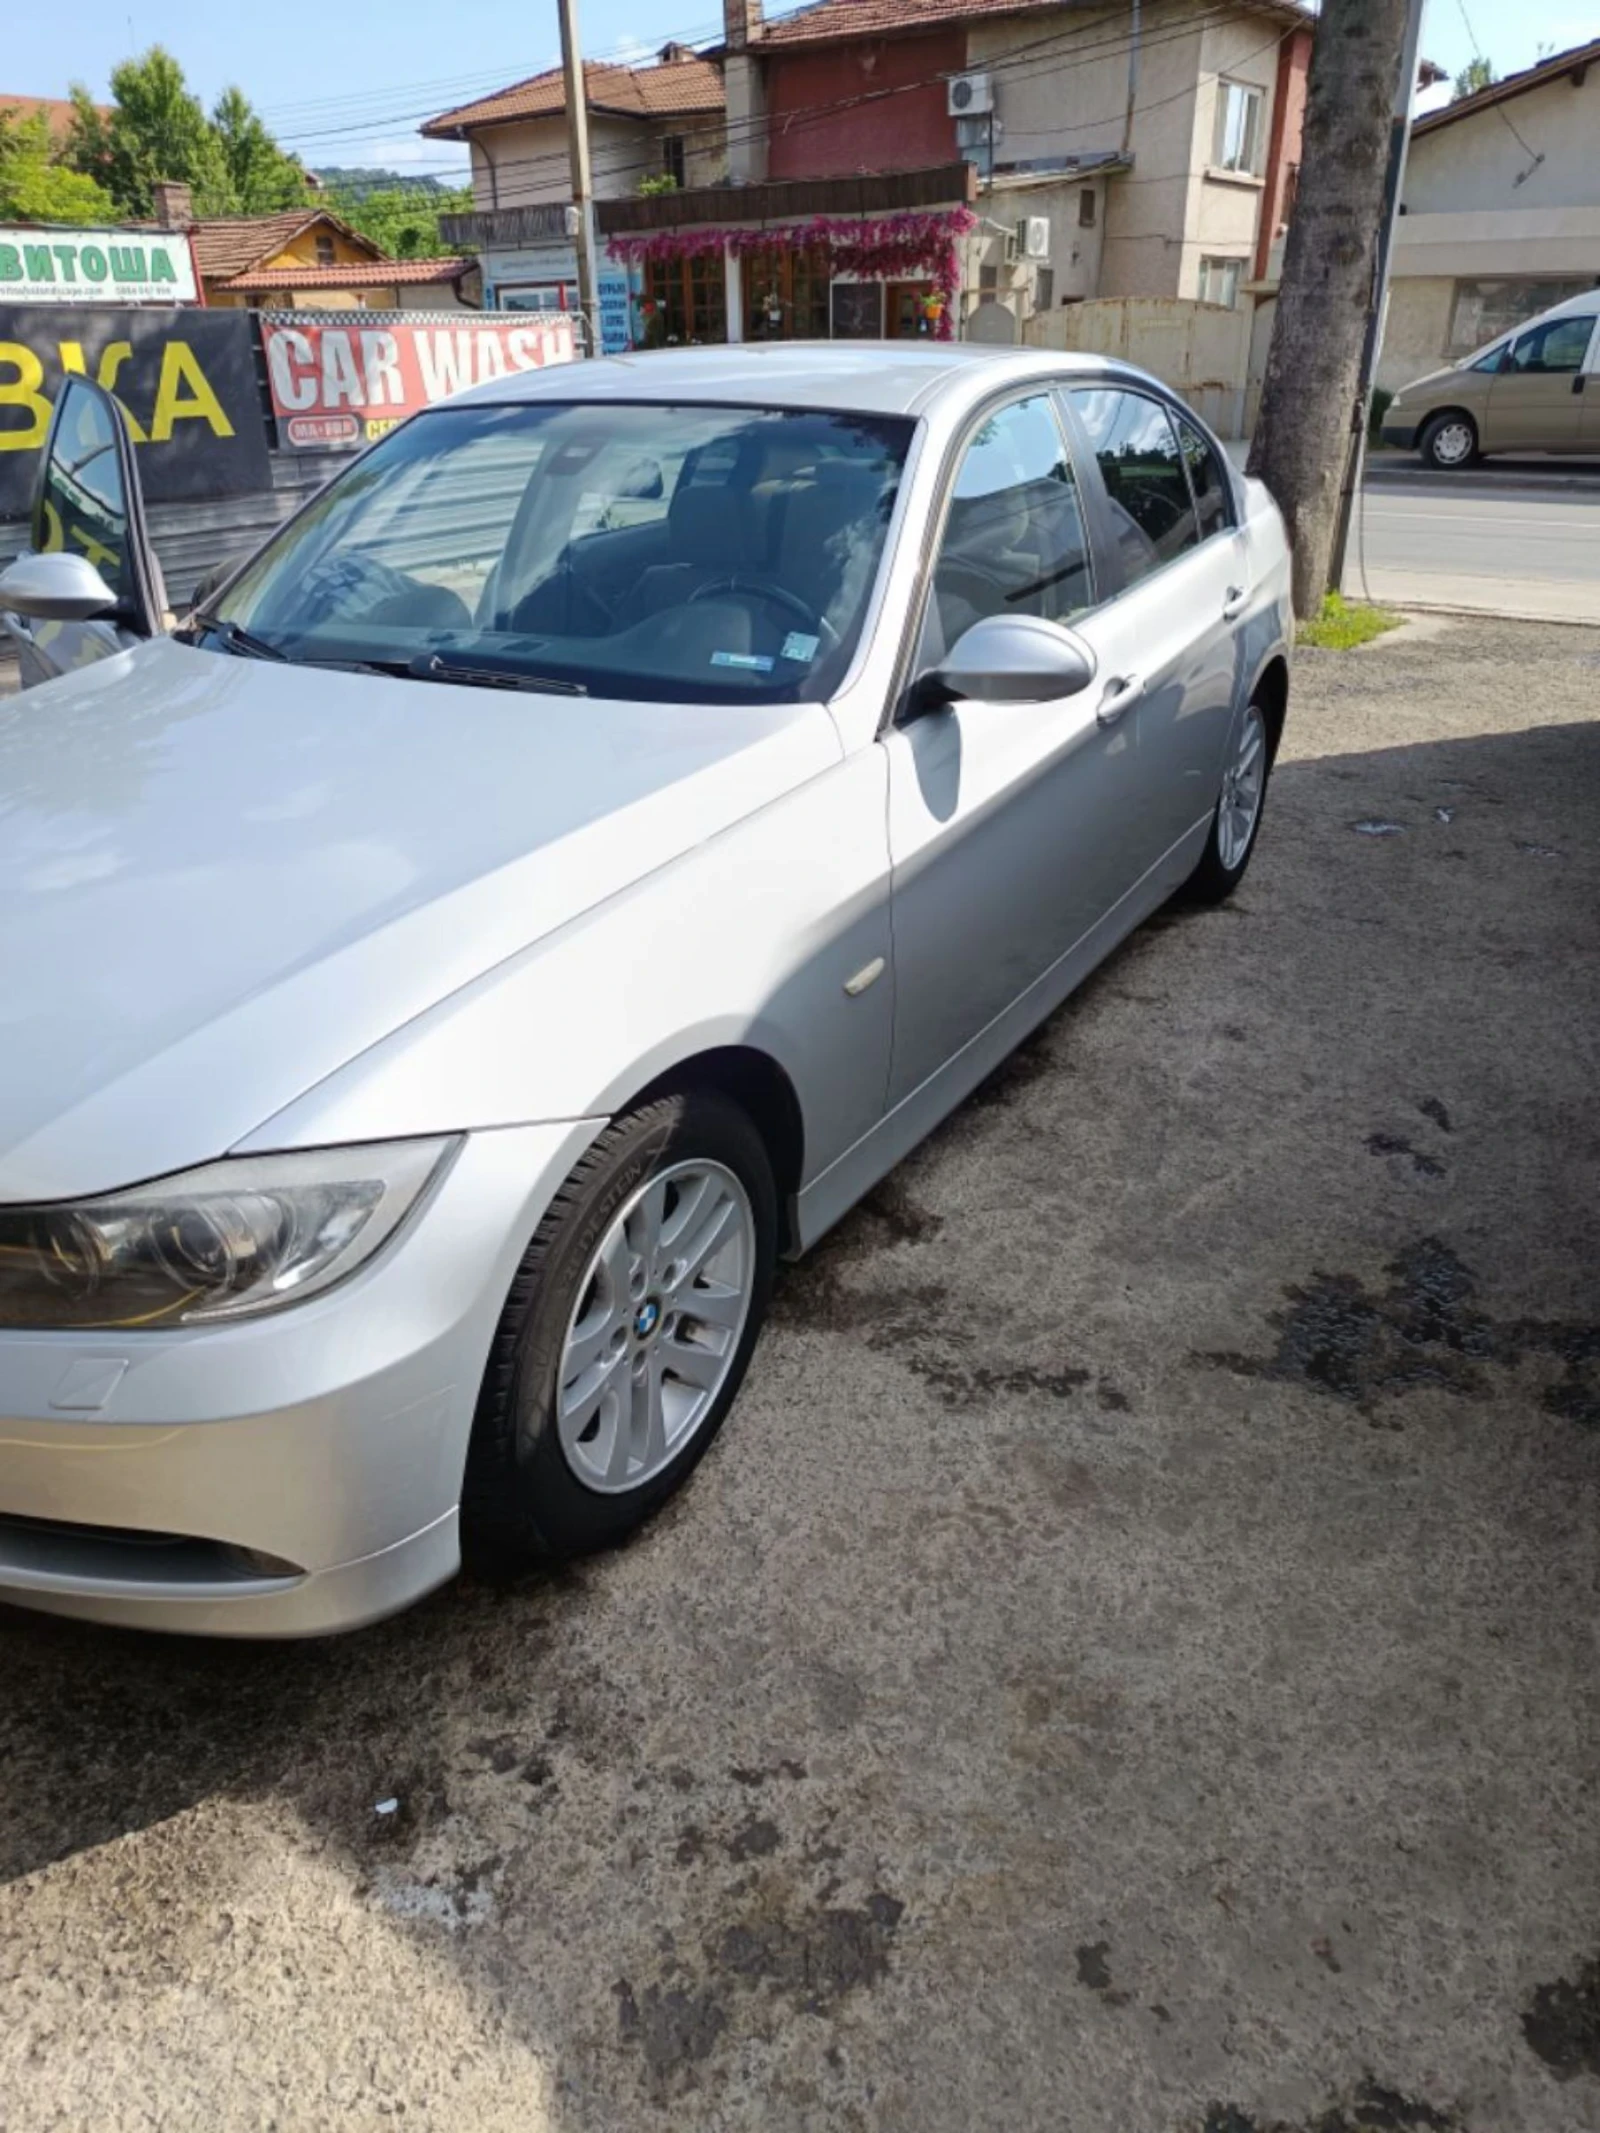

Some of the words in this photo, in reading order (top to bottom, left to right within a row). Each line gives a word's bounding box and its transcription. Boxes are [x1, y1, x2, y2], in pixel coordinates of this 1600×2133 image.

[0, 244, 177, 283] ВИТОША
[267, 328, 405, 411] CAR
[413, 326, 574, 402] WASH
